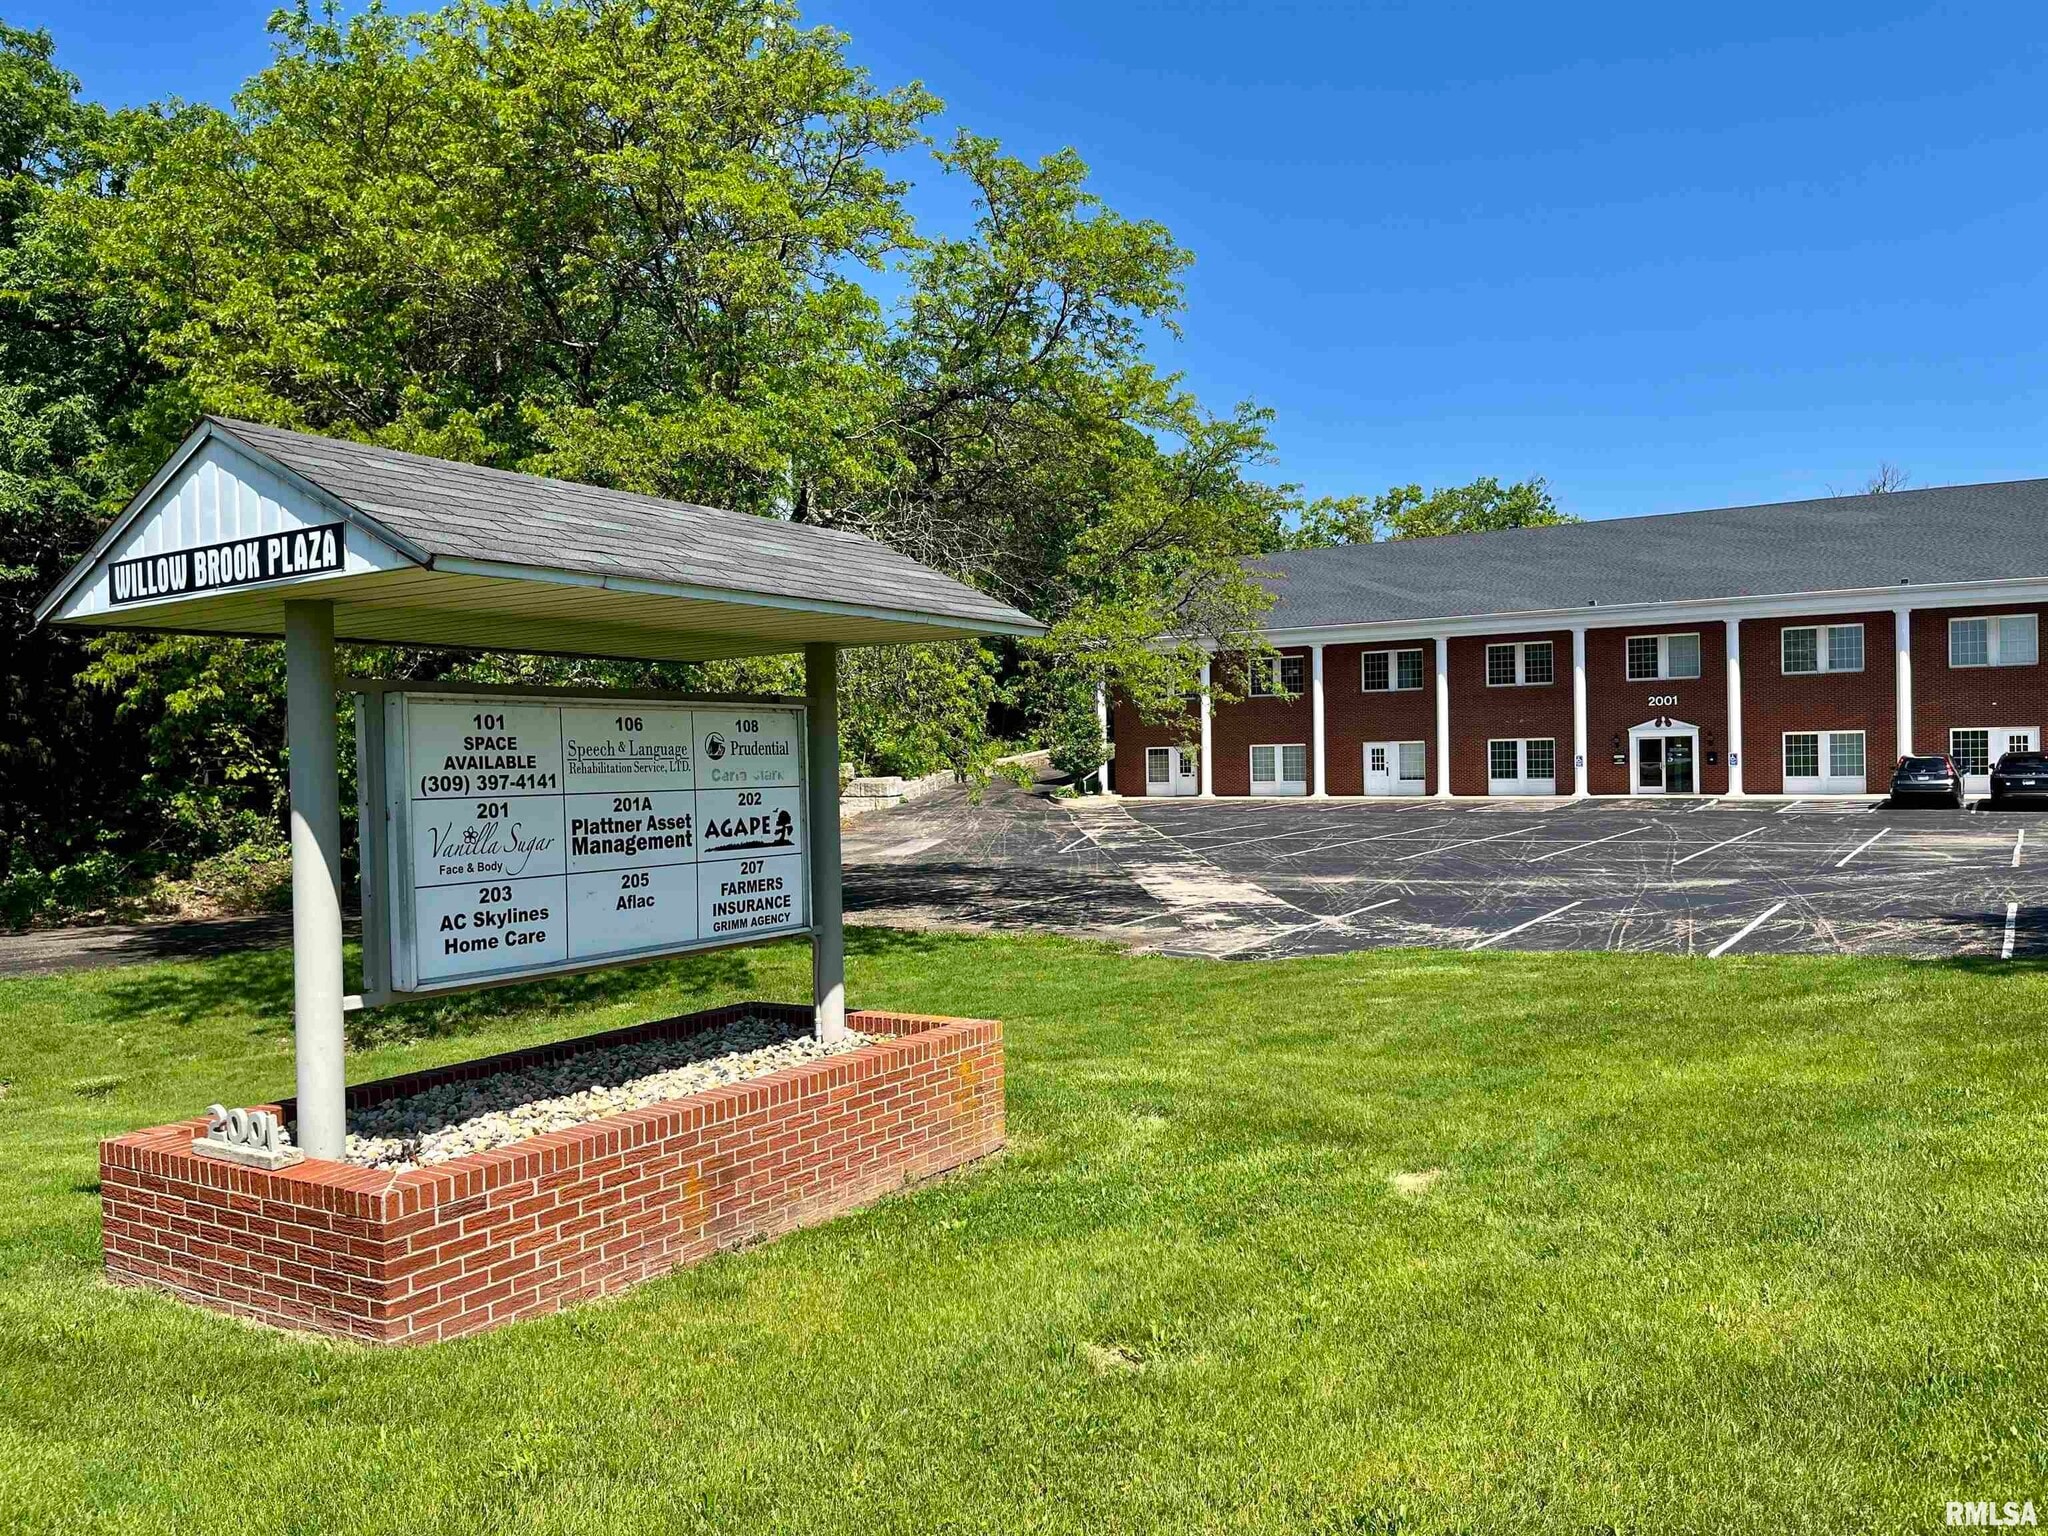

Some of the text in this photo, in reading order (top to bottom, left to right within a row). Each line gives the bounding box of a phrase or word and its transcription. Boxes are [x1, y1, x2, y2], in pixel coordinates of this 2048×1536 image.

[114, 529, 337, 600] WILLOW BROOK PLAZA
[1648, 695, 1678, 707] 2001
[473, 714, 505, 730] 101
[615, 717, 643, 732] 106
[735, 719, 759, 733] 108
[463, 736, 517, 751] SPACE
[567, 739, 688, 764] Speech & Language
[730, 740, 790, 756] Prudential
[443, 755, 537, 770] AVAILABLE
[569, 759, 691, 775] Rehabilitation Service, LTD.
[420, 773, 557, 796] (309) 397-4141
[613, 796, 653, 812] 201A
[737, 792, 762, 806] 202
[476, 802, 509, 819] 201
[571, 813, 692, 836] Plattner Asset
[704, 815, 771, 839] AGAPE
[427, 821, 555, 876] Vanilla Sugar
[571, 830, 693, 856] Management
[439, 861, 503, 875] Face & Body
[740, 860, 764, 875] 207
[621, 872, 649, 890] 205
[721, 877, 783, 897] FARMERS
[479, 886, 512, 904] 203
[616, 895, 655, 911] Aflac
[712, 894, 791, 917] INSURANCE
[440, 907, 549, 932] AC Skylines
[713, 912, 791, 932] GRIMM AGENCY
[444, 930, 546, 955] Home Care
[205, 1103, 278, 1153] 2001
